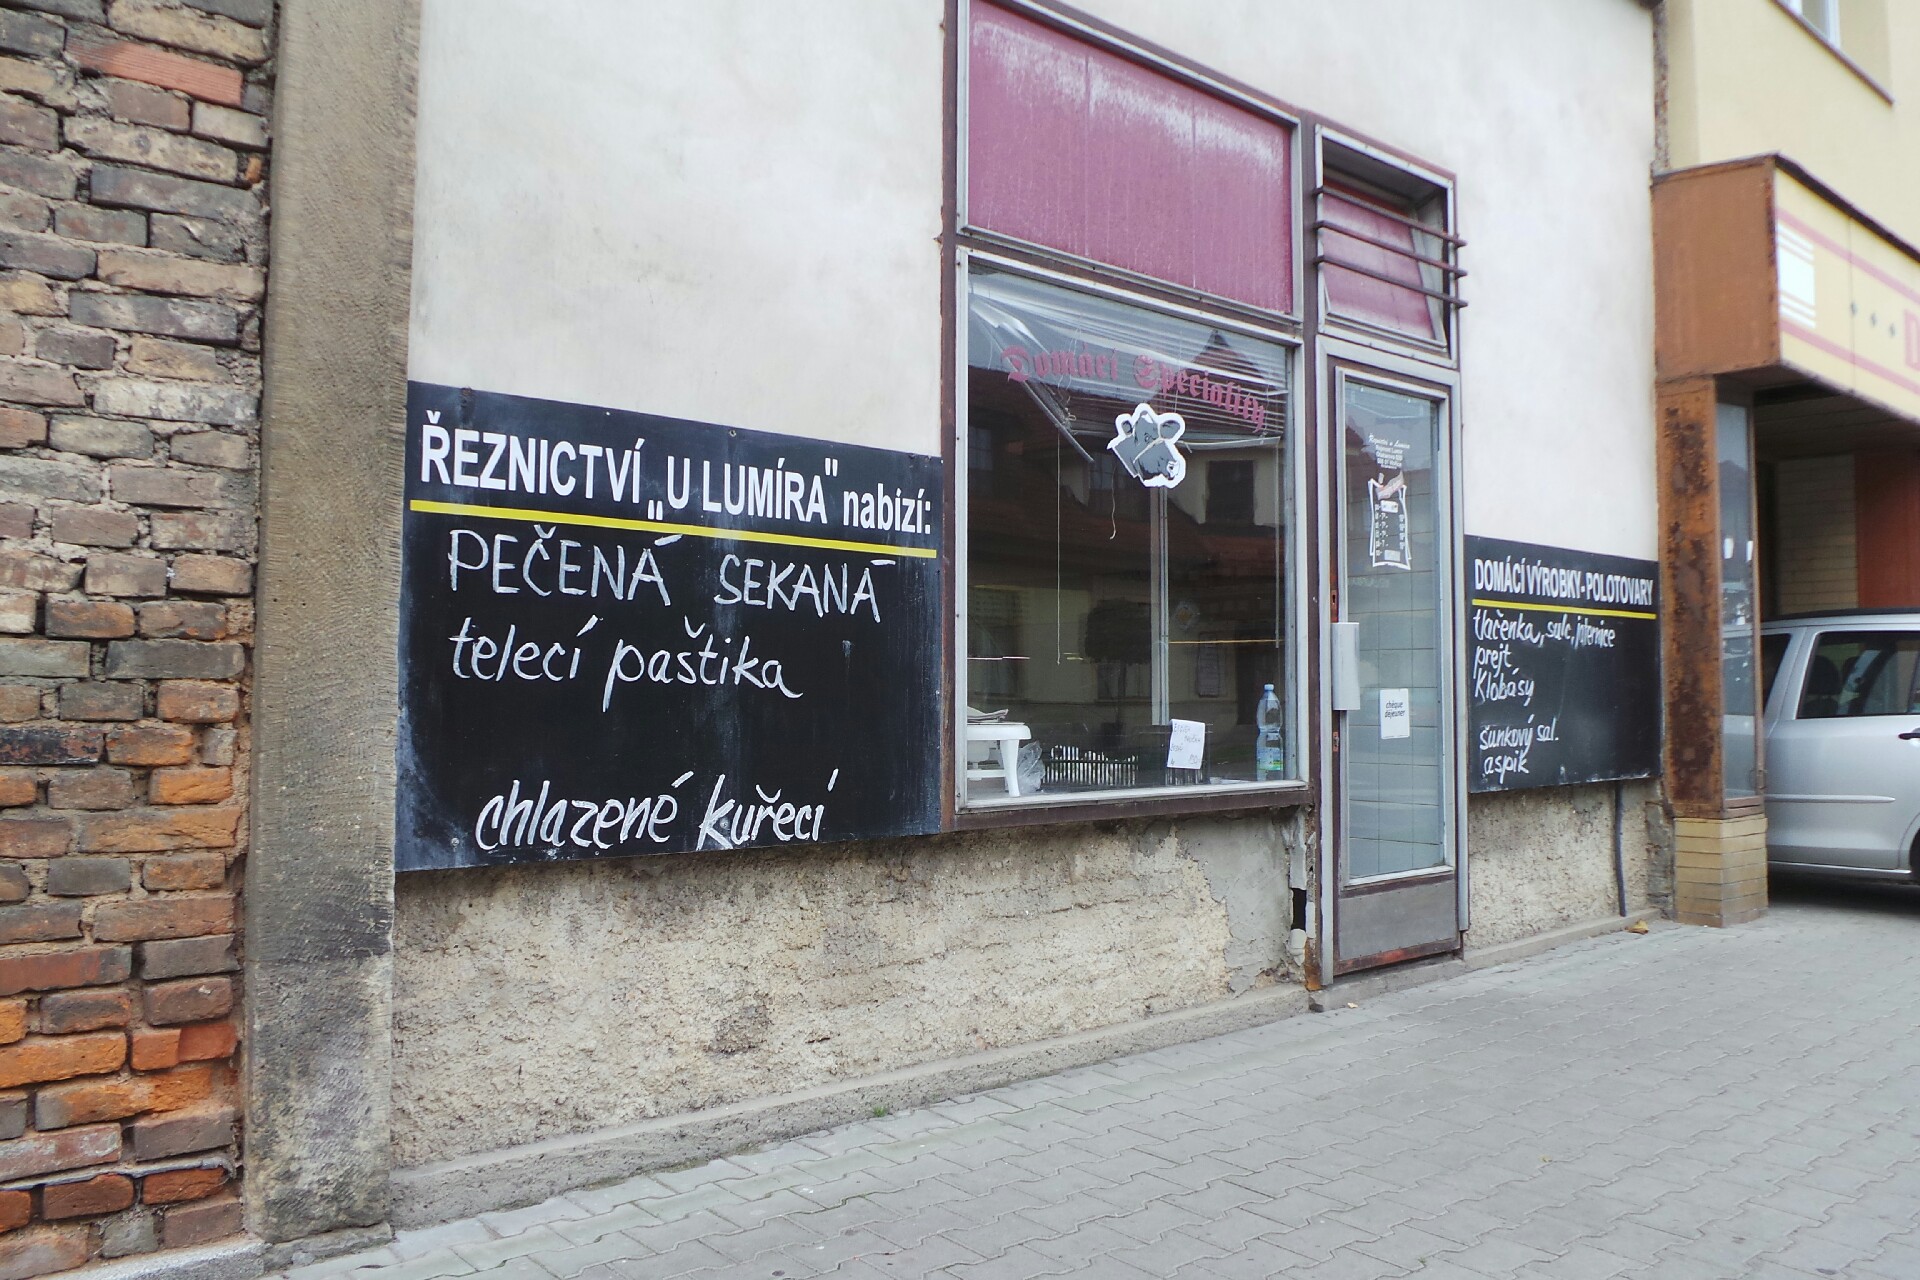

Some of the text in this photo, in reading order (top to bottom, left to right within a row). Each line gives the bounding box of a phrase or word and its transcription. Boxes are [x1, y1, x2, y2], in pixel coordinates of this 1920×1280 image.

[421, 410, 645, 504] ŘEZNICTVÍ
[447, 524, 897, 623] PEČENÁ SEKANÁ
[1474, 555, 1526, 594] DOMÁCÍ
[448, 615, 804, 713] telecí paštika
[1473, 643, 1512, 680] prejt
[1483, 750, 1530, 784] aspik
[475, 768, 839, 851] chlazené kuřecí
